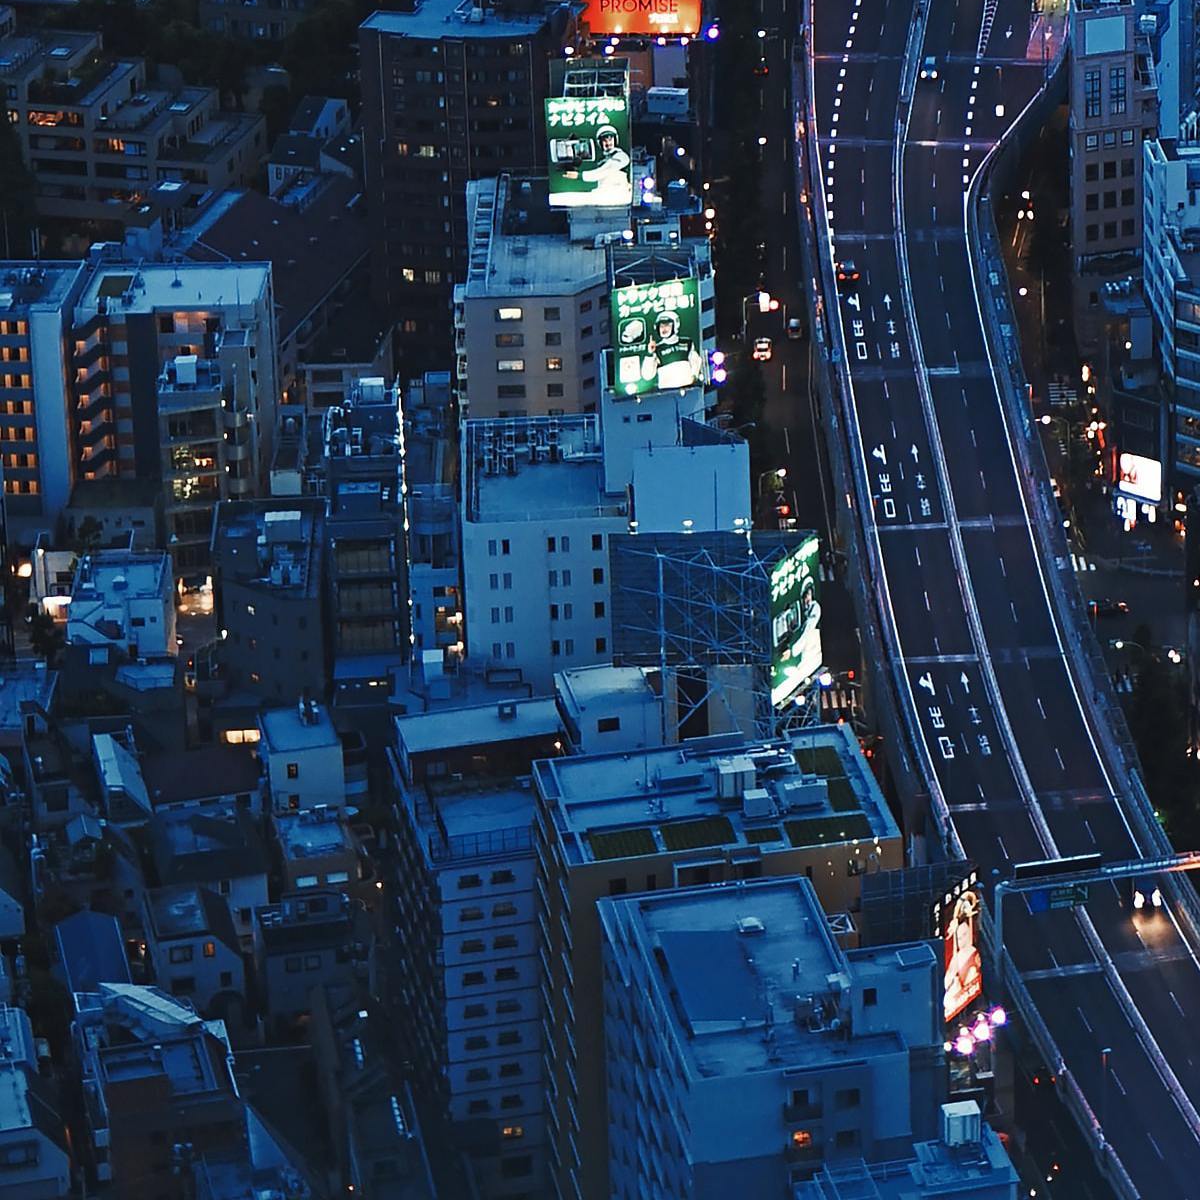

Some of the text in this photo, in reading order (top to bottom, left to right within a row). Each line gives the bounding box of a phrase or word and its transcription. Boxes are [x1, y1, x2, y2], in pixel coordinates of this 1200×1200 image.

[548, 111, 610, 127] ナビタイム
